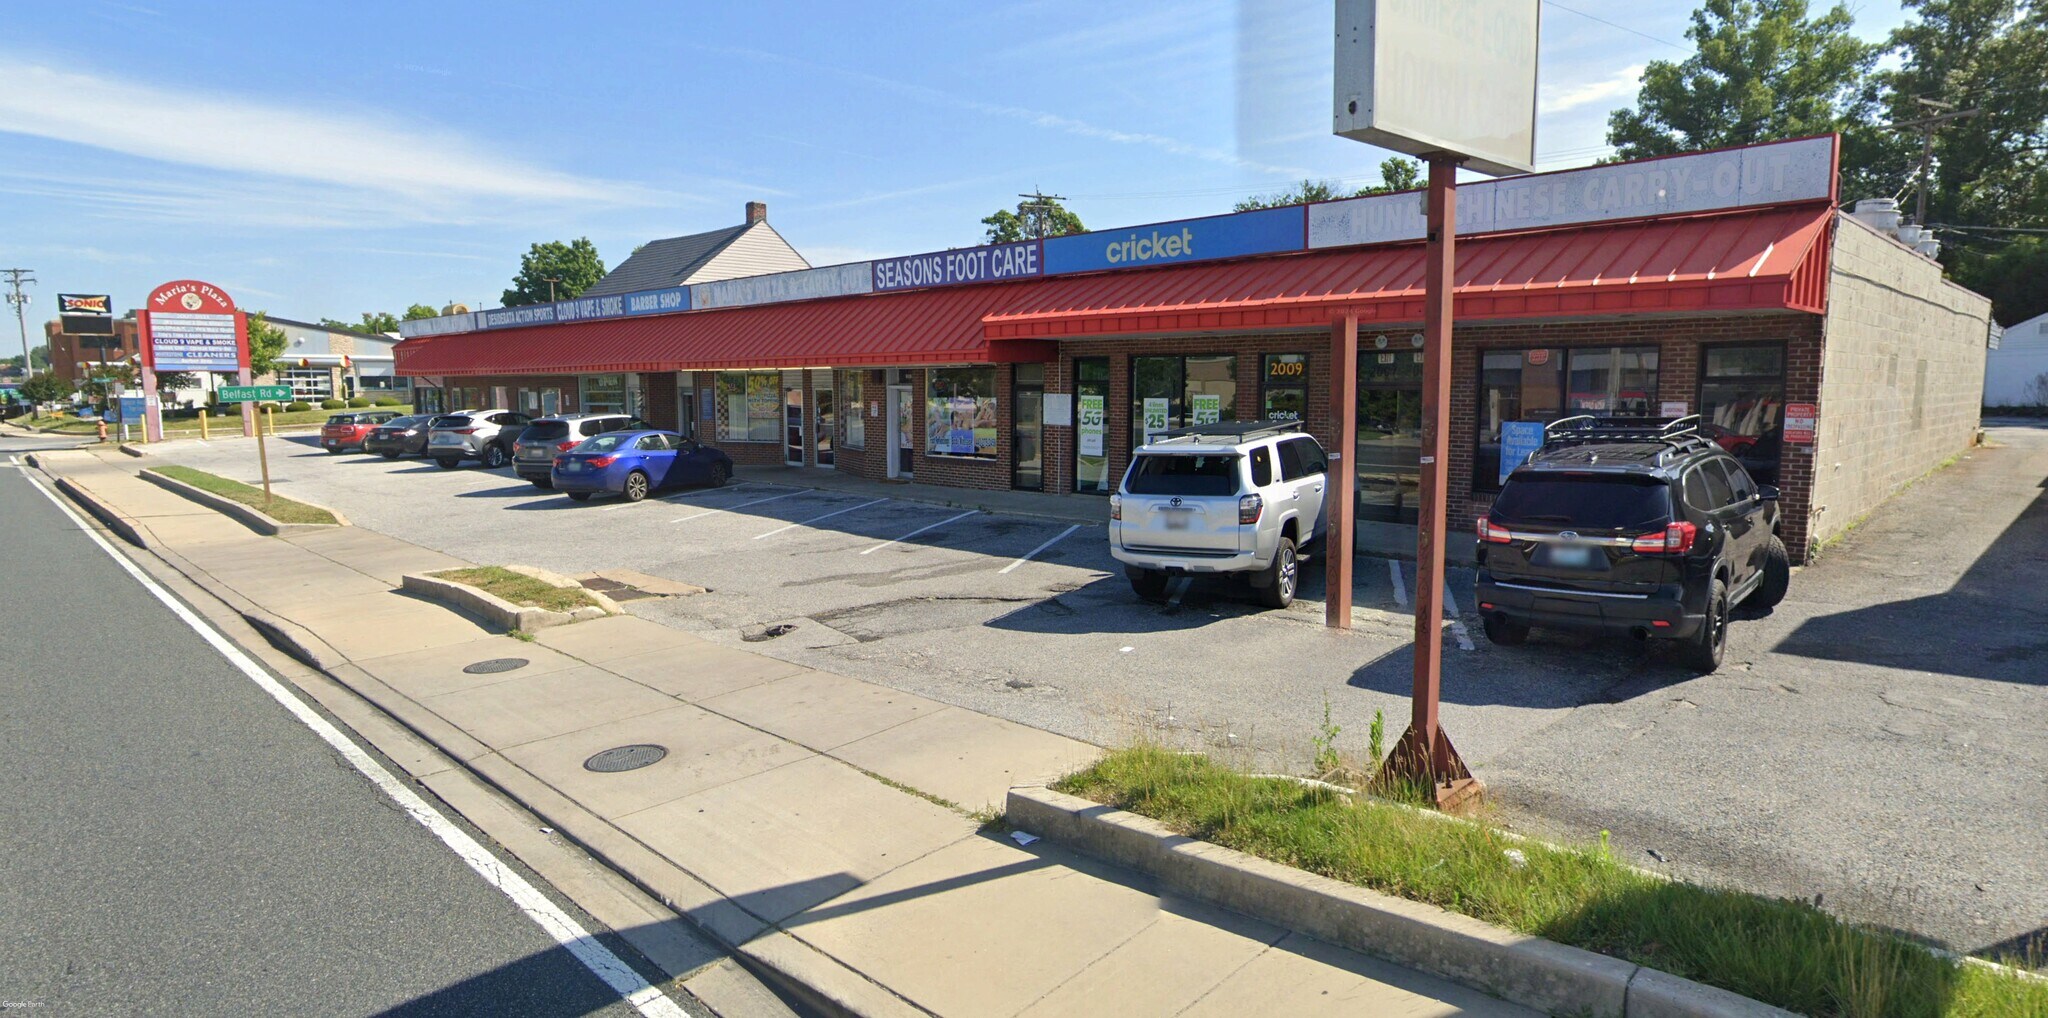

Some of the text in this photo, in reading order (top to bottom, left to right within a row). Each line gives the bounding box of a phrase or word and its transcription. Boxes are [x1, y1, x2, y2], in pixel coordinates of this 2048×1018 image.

[1351, 202, 1423, 236] HUNA
[1583, 152, 1791, 210] CARRY-OUT
[1106, 228, 1192, 263] cricket
[877, 245, 1037, 288] SEASONS FOOT CARE
[755, 278, 785, 298] PIZZA
[155, 284, 228, 308] Maria's Plaza
[631, 292, 681, 311] BARBER SHOP
[67, 299, 107, 308] SONIC
[557, 296, 623, 320] CLOUD 9 VAPE & SMOKE
[488, 311, 515, 326] DESIDERATA
[515, 309, 533, 324] ACTION
[533, 307, 554, 321] SPORTS
[1270, 363, 1303, 375] 2009
[222, 389, 272, 399] Belfast Rd
[1082, 399, 1103, 409] FREE
[1194, 399, 1218, 409] FREE
[1082, 411, 1102, 425] 5G
[1145, 414, 1165, 428] $25
[1269, 411, 1299, 419] cricket
[1512, 424, 1534, 436] Space
[1507, 436, 1538, 446] Available
[1505, 447, 1514, 456] for
